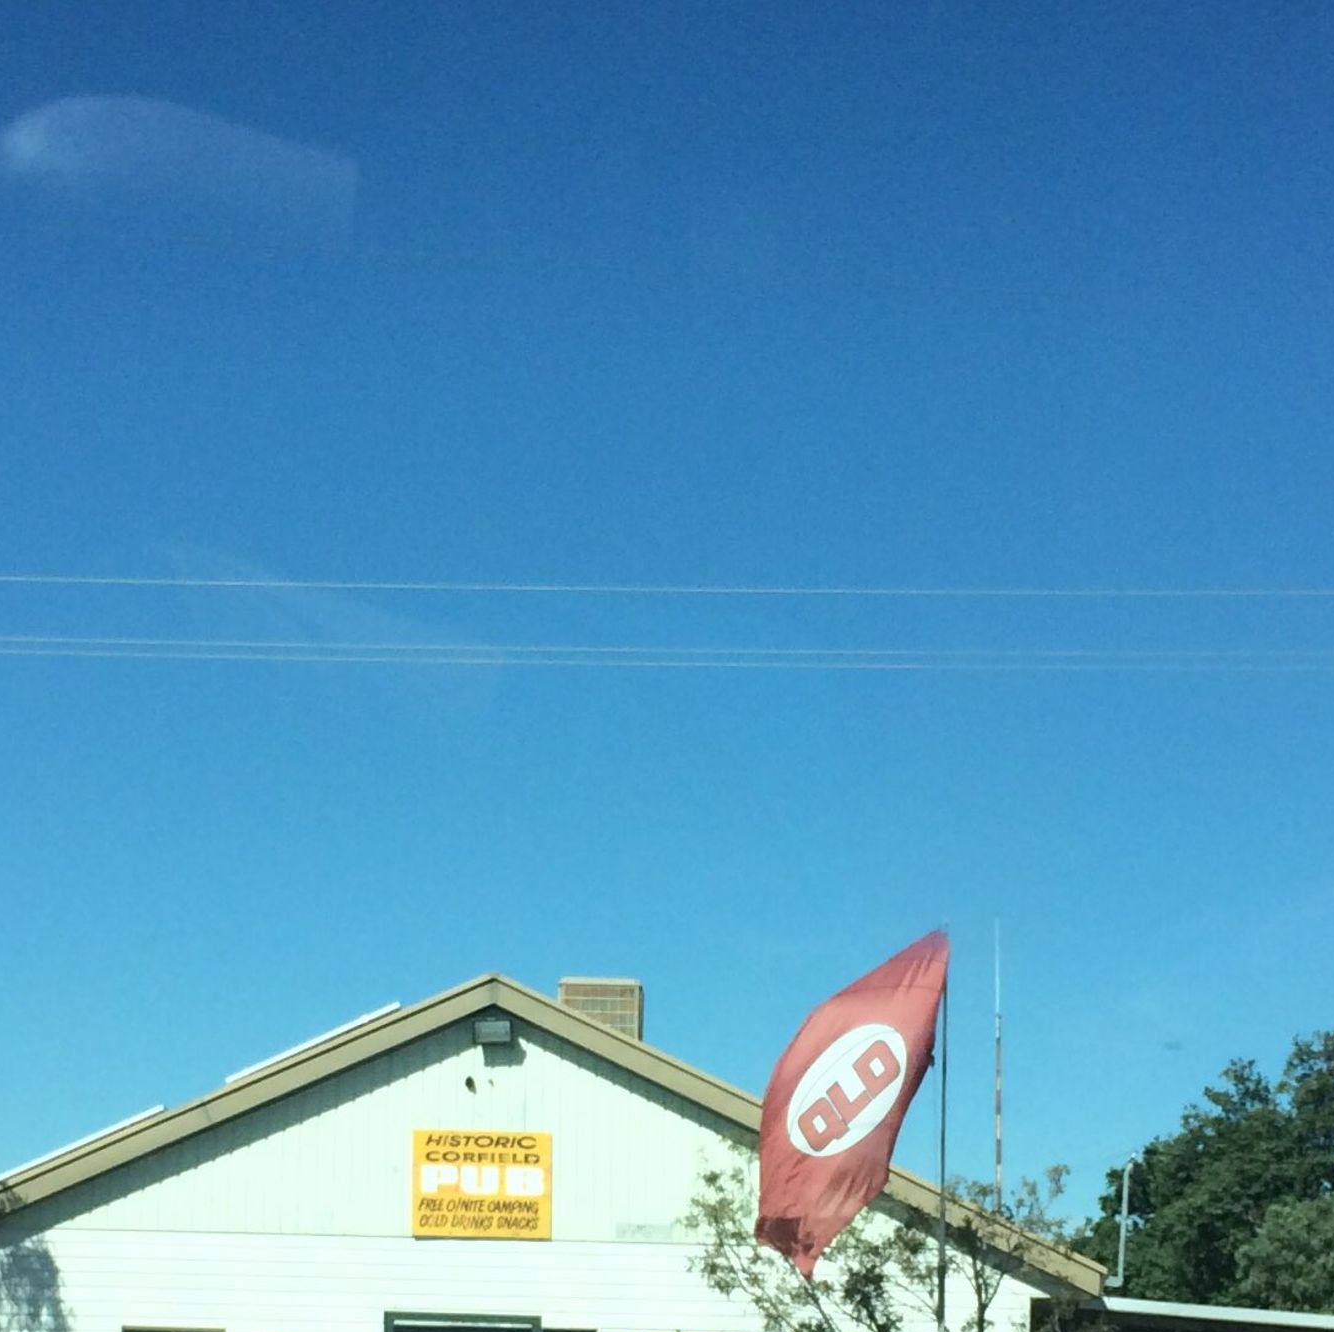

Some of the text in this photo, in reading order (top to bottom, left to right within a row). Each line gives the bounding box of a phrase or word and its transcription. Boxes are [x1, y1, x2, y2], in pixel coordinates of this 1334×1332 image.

[798, 1039, 901, 1152] QLD
[425, 1134, 538, 1150] HISTORIC
[425, 1150, 541, 1165] CORFIELD
[420, 1164, 545, 1196] PUB
[419, 1198, 444, 1212] FREE
[487, 1200, 539, 1215] CAMPING
[450, 1215, 494, 1230] DRINKS
[497, 1216, 539, 1231] SNACKS
